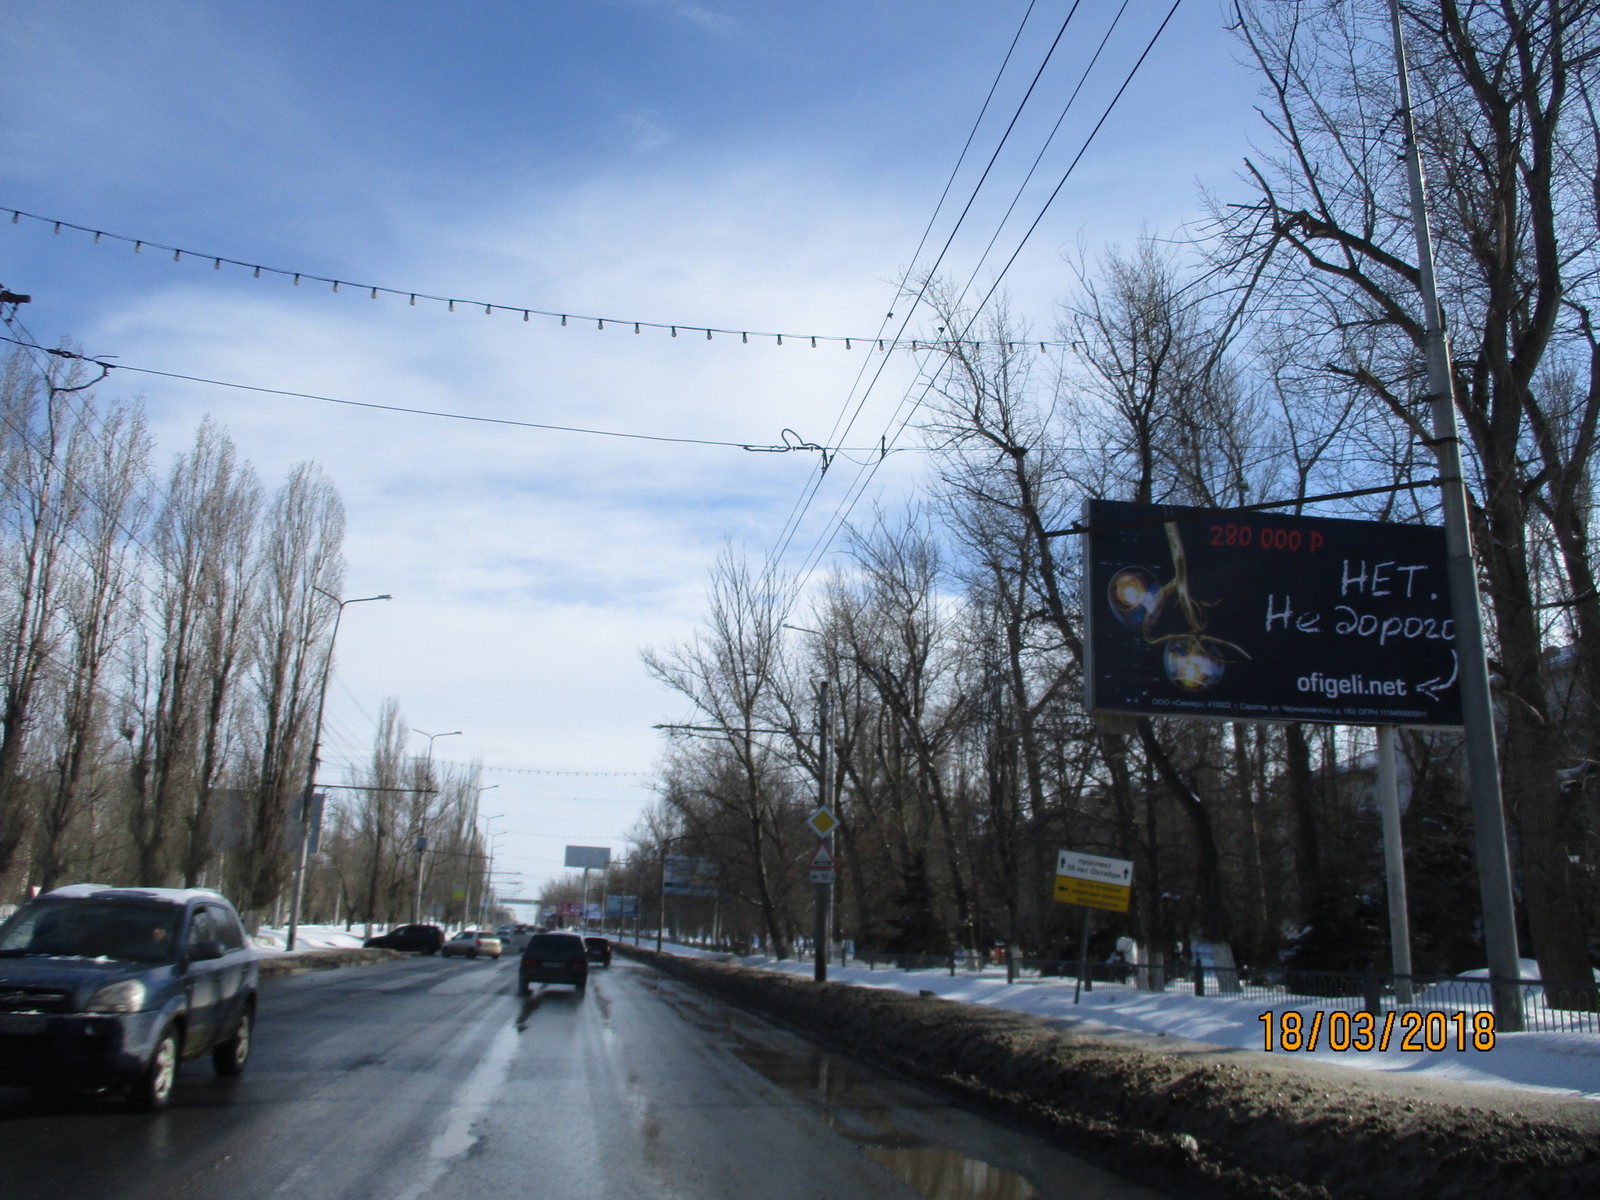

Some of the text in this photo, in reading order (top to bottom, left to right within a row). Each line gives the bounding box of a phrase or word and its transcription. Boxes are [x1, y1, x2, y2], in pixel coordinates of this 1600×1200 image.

[1210, 524, 1251, 546] 280
[1260, 528, 1302, 550] 000
[1342, 559, 1438, 600] НЕТ.
[1266, 594, 1325, 632] Не
[1297, 672, 1407, 699] ofigeli.net
[1152, 698, 1170, 706] ООО
